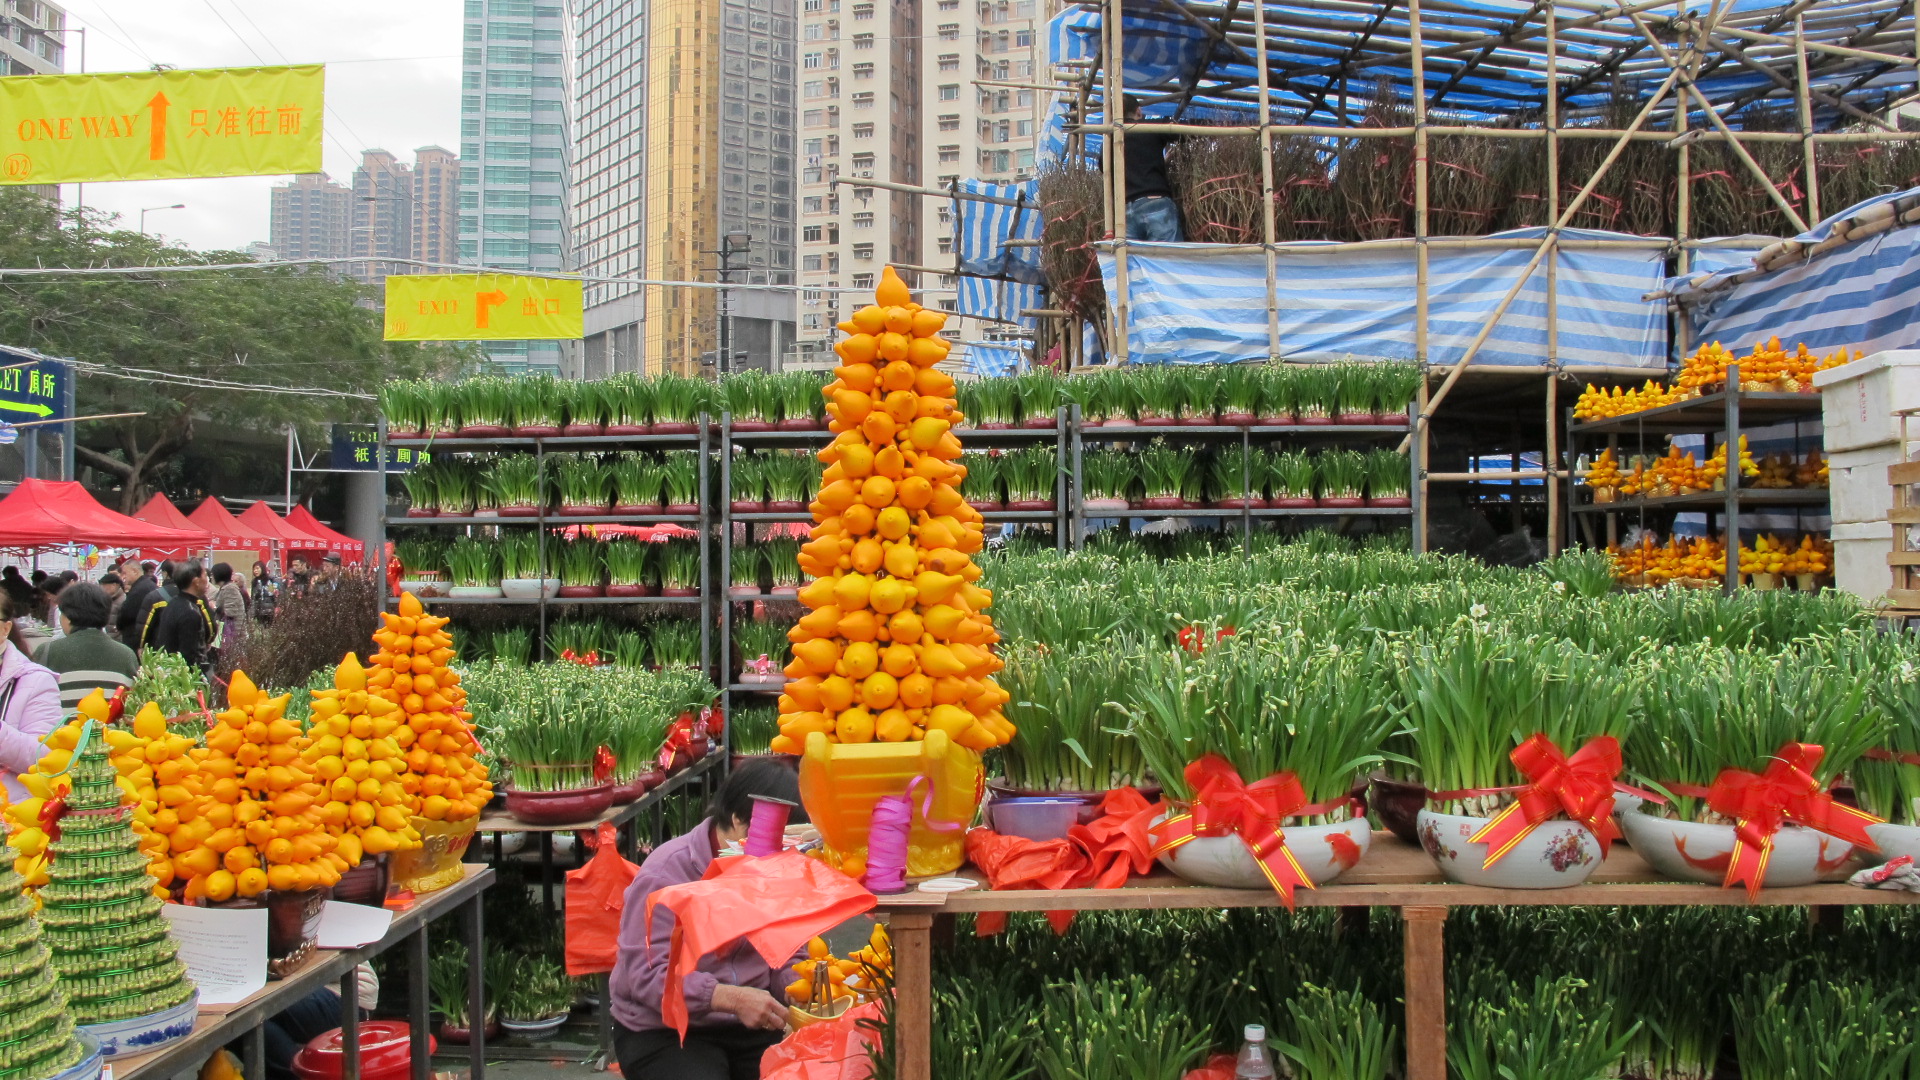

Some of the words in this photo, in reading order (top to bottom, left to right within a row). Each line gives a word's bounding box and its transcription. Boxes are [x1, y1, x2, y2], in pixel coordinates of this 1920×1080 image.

[18, 117, 73, 142] ONE
[80, 114, 140, 138] WAY
[186, 104, 303, 139] 只准往前
[418, 299, 459, 316] EXIT
[522, 297, 560, 316] 出口
